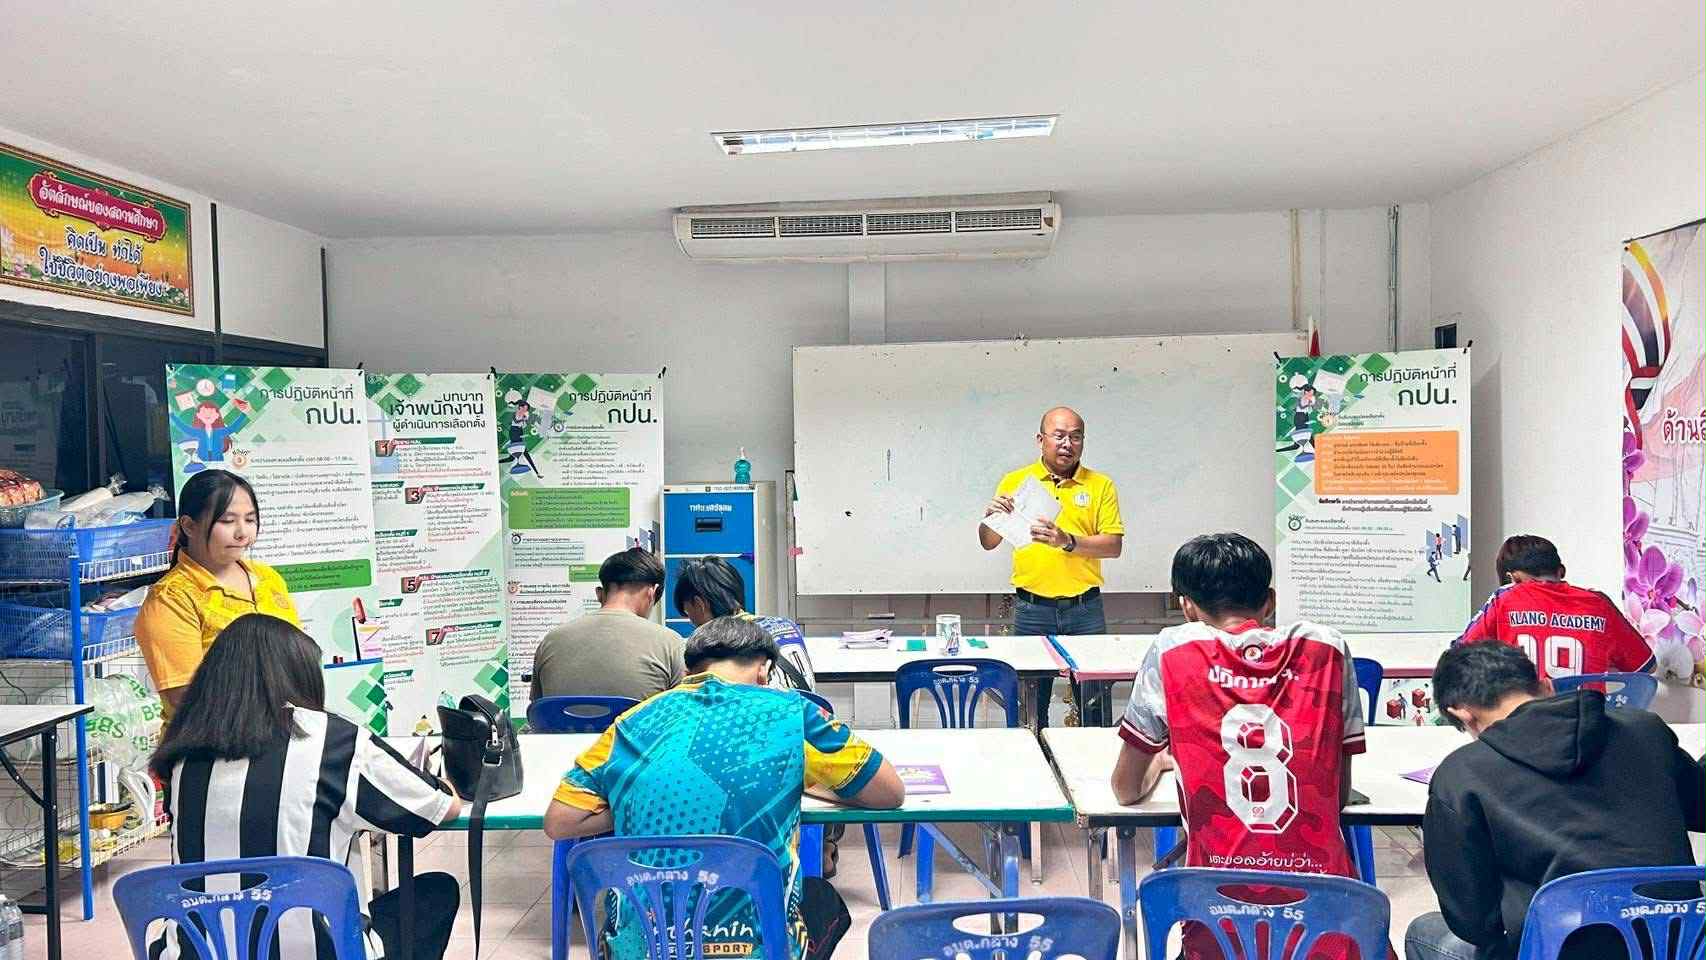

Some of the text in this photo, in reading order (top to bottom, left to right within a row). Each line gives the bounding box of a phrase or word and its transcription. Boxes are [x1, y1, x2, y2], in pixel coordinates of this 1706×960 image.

[38, 180, 158, 231] อัตลักษณ์ของสถานศึกษา
[64, 224, 143, 265] คิดเป็น ทำได้
[40, 247, 164, 297] ใช้ชีวิตอย่างพอเพียง
[1360, 362, 1456, 385] การปฏิบัติหน้าที่
[260, 384, 354, 401] การปฏิบัติหน้าที่
[442, 392, 483, 402] บทบาท
[569, 387, 652, 403] การปฏิบัติหน้าที่
[1398, 383, 1457, 406] กปน.
[306, 402, 361, 425] กปน.
[390, 400, 484, 416] เจ้าพนักงาน
[608, 403, 658, 423] กปน.
[393, 416, 486, 432] ผู้ดำเนินการเลือกตั้ง
[1509, 611, 1606, 632] KLANG ACADEMY
[1221, 704, 1299, 834] 8
[697, 871, 720, 885] 55
[250, 889, 273, 902] 55
[1282, 907, 1305, 921] 55
[1696, 903, 1706, 914] 5
[1028, 936, 1054, 952] 55
